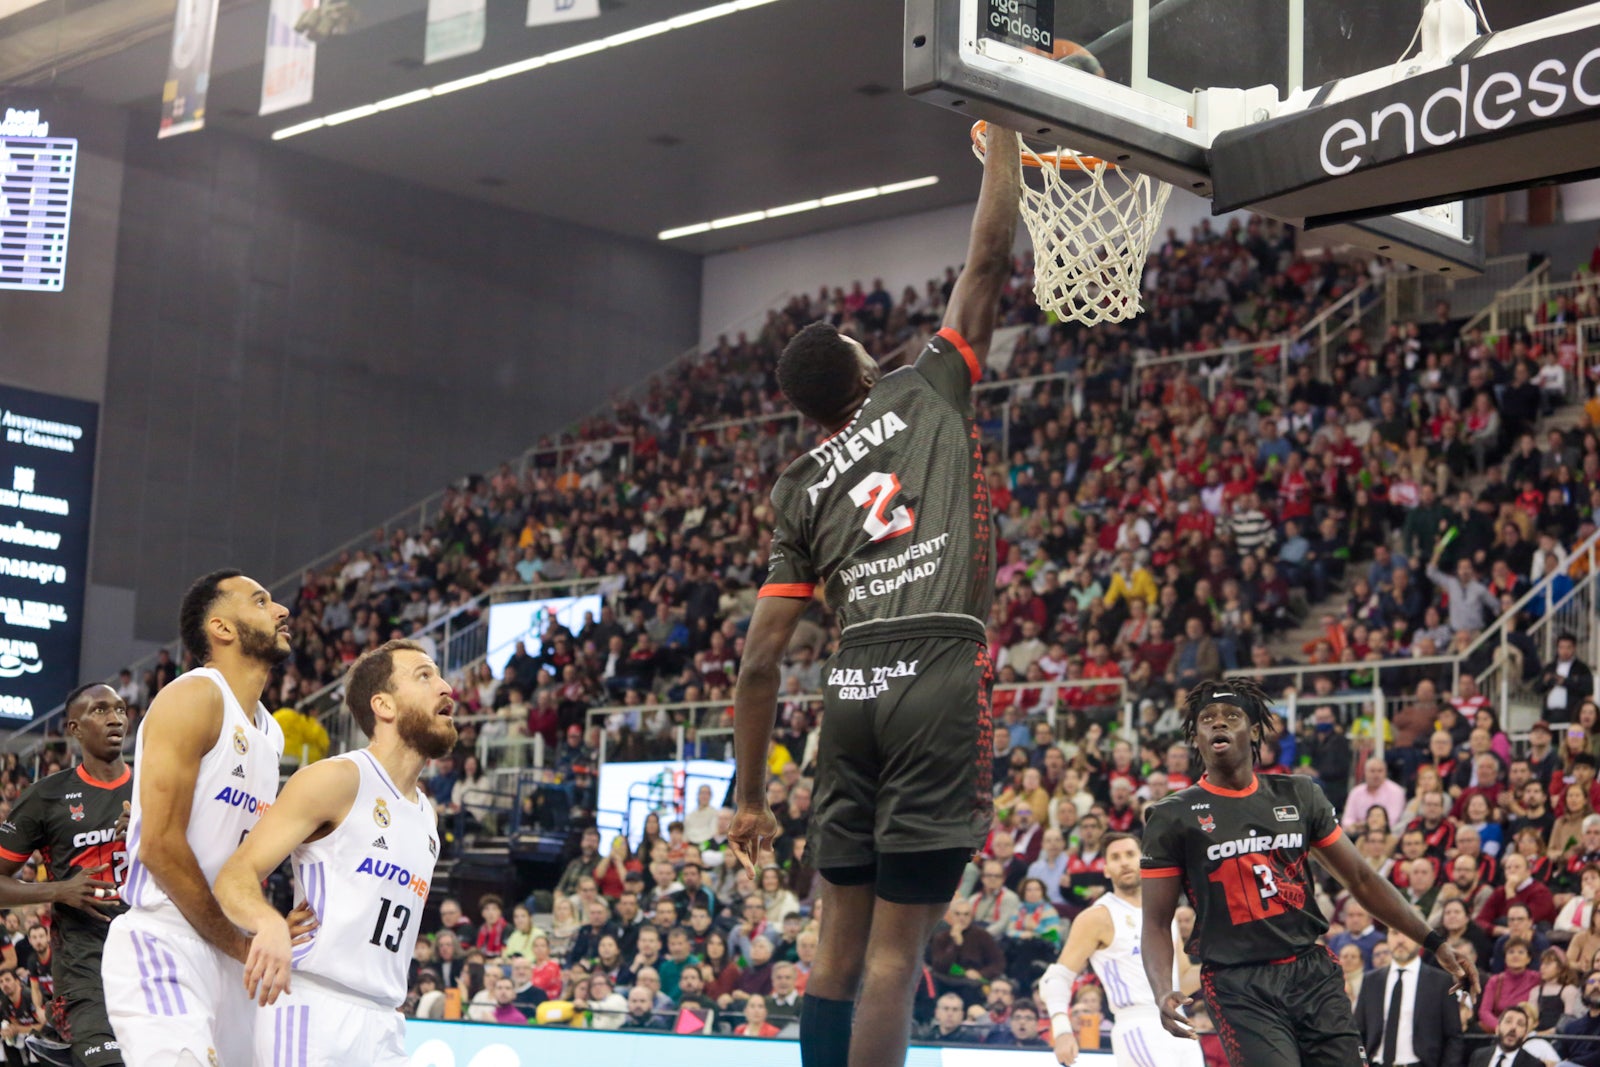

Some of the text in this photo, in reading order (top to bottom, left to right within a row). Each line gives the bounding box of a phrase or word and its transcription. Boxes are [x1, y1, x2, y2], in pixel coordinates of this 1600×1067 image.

[990, 11, 1051, 47] endesa
[848, 471, 915, 542] 2
[869, 558, 942, 596] GRANAD
[1252, 863, 1278, 900] 3
[369, 897, 411, 953] 13
